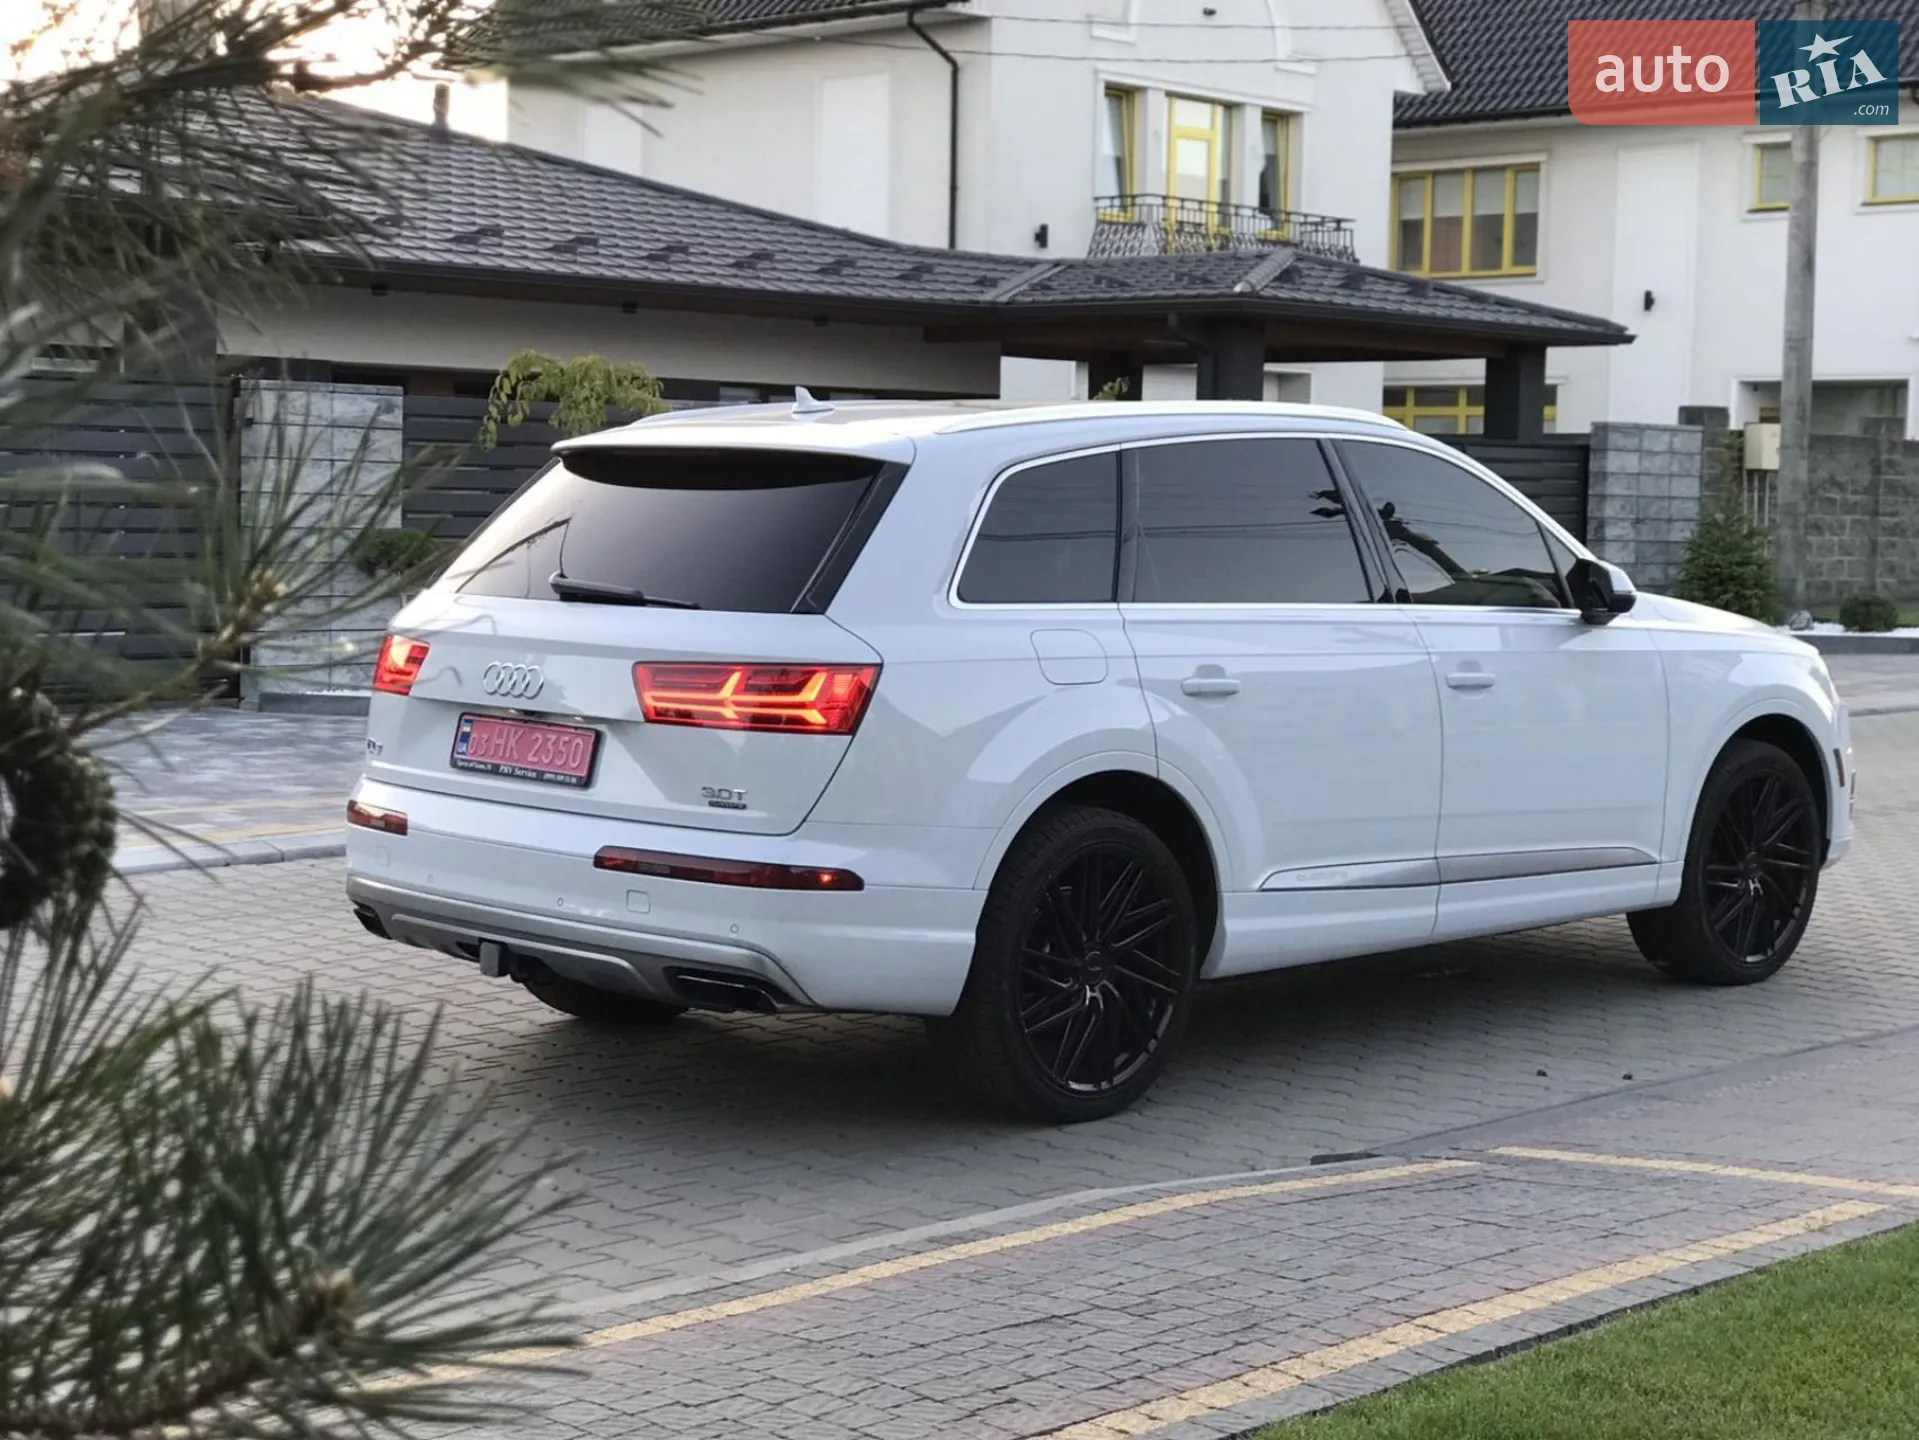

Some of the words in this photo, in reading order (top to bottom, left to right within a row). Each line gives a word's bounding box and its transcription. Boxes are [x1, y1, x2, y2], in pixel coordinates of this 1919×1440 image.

[490, 727, 523, 759] HK
[527, 733, 584, 769] 2350
[513, 767, 537, 779] Service
